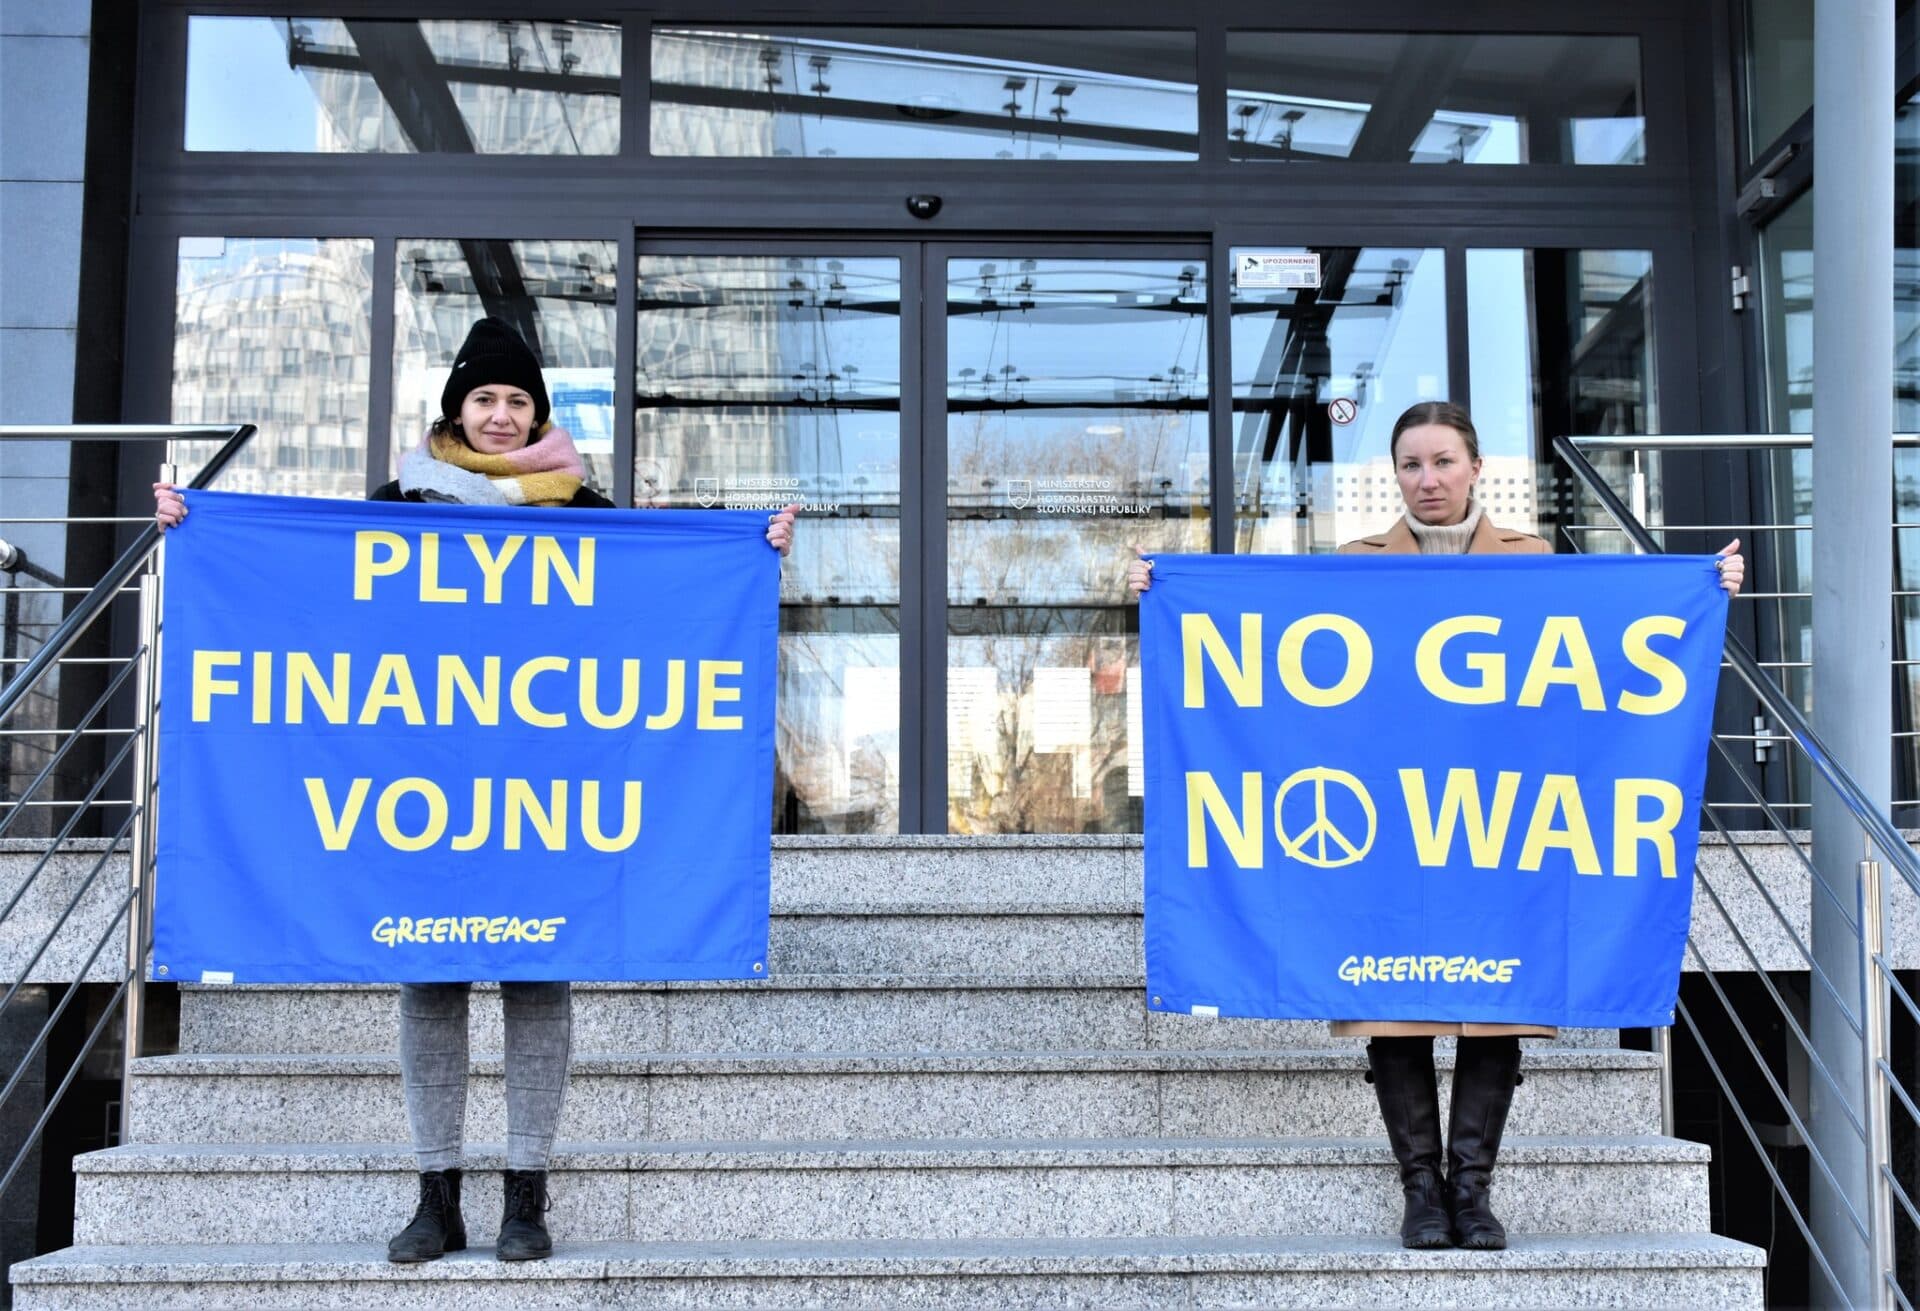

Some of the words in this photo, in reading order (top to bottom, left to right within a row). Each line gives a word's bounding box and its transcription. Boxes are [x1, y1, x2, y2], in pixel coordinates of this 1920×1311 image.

[724, 478, 799, 487] MINISTERSTVO
[1036, 480, 1110, 489] MINISTERSTVO
[1036, 493, 1118, 504] HOSPODÁRSTVA
[1036, 504, 1096, 515] SLOVENSKEJ
[1099, 505, 1152, 514] REPUBLIKY
[353, 530, 596, 607] PLYN
[1180, 612, 1374, 709] NO
[1415, 614, 1688, 716] GAS
[191, 649, 744, 732] FINANCUJE
[303, 777, 643, 853] VOJNU
[1397, 767, 1684, 879] WAR
[370, 915, 567, 948] GREENPEACE
[1337, 955, 1522, 987] GREENPEACE
